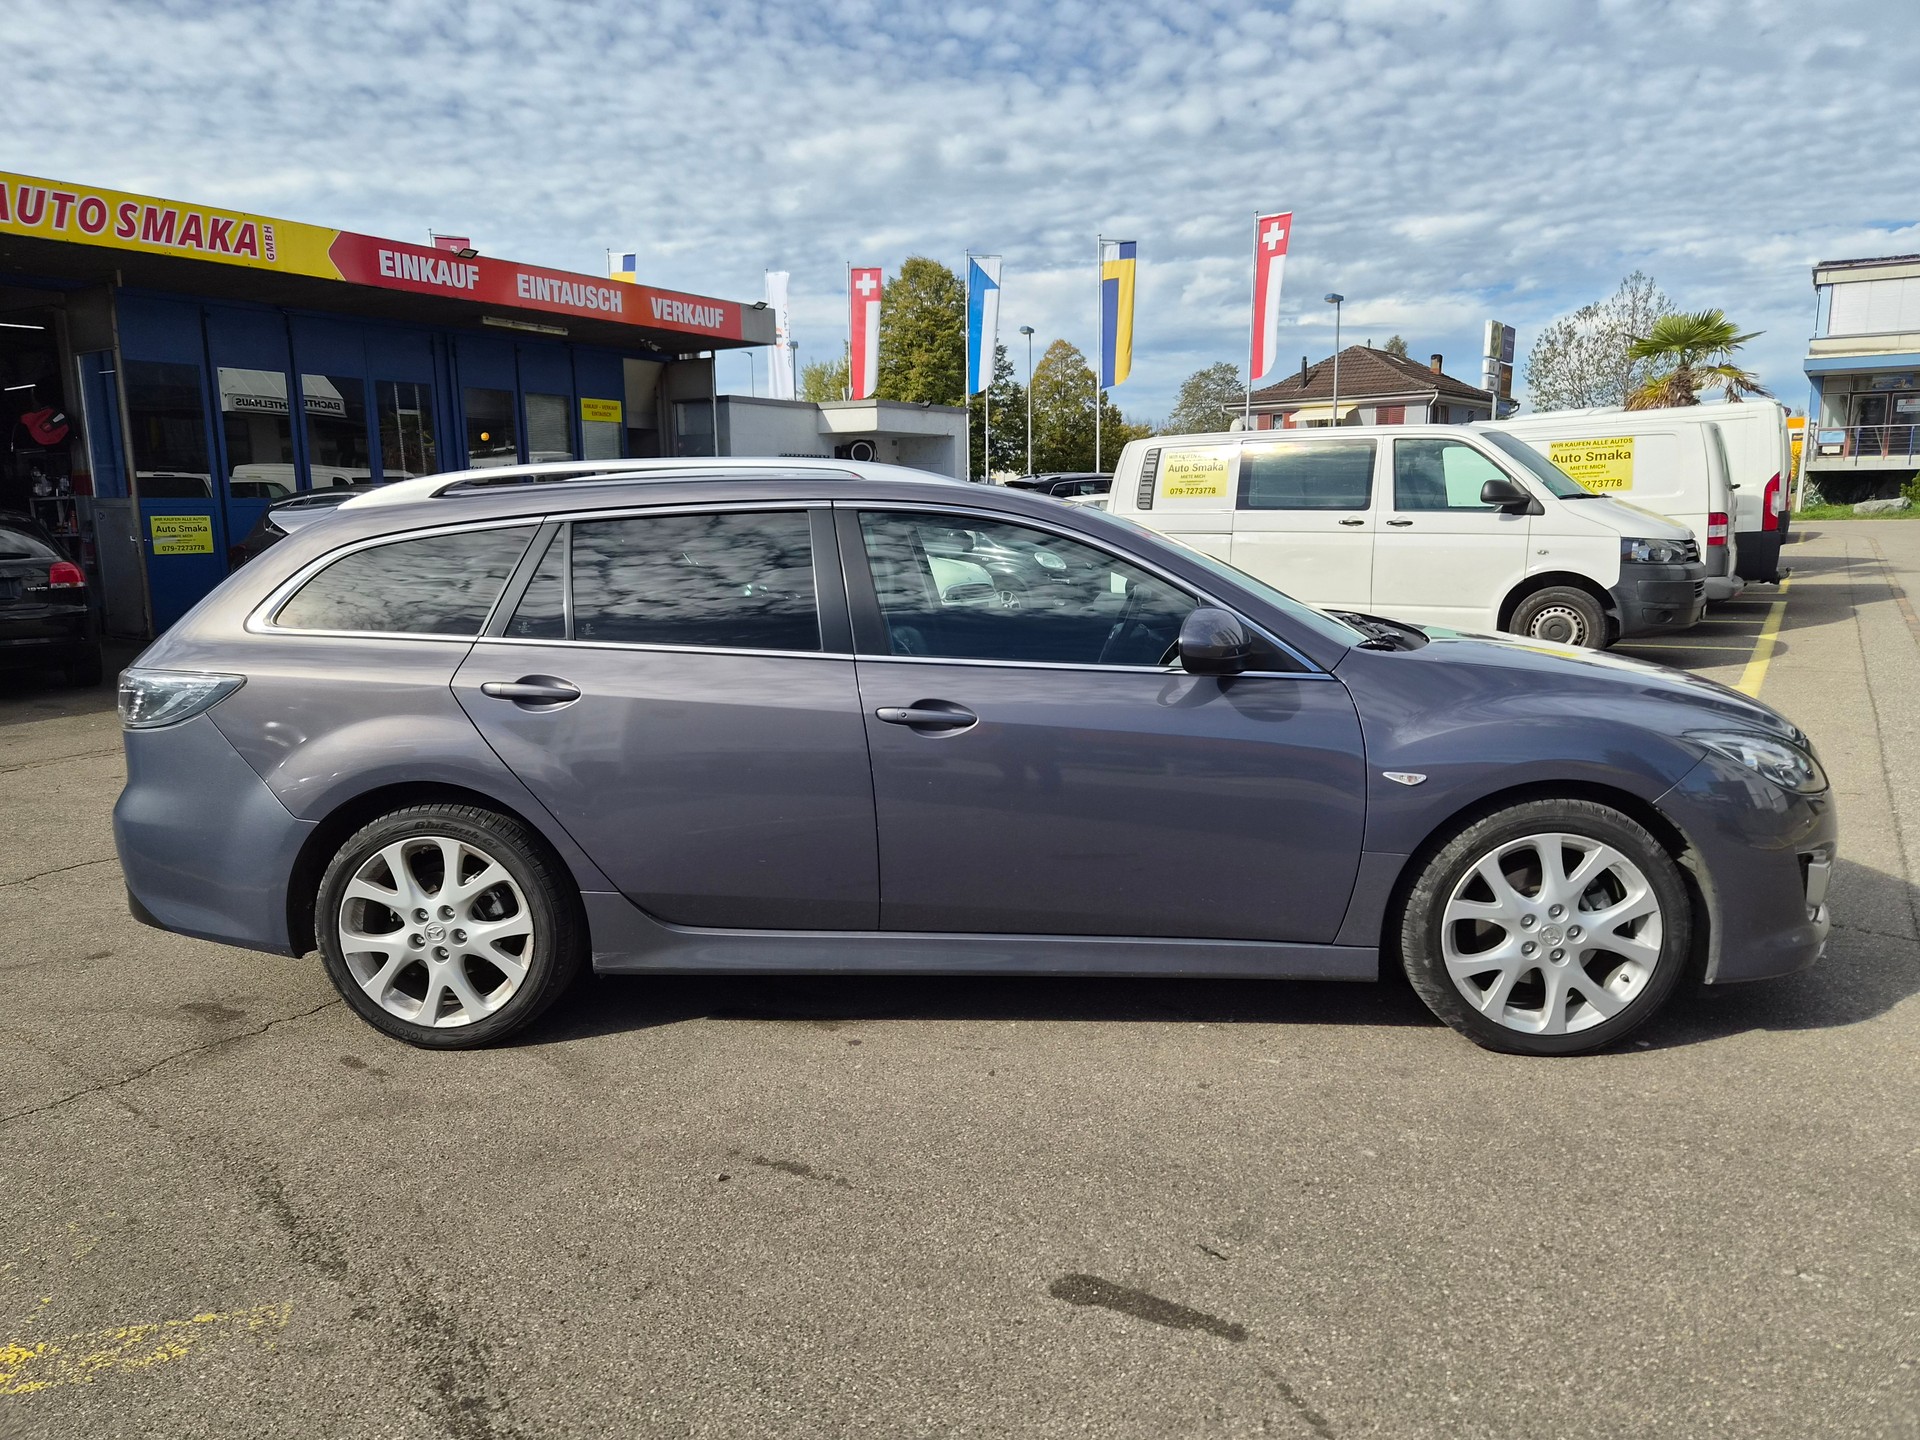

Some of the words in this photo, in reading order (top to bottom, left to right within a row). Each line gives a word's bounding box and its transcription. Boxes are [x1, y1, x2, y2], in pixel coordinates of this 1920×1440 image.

[115, 202, 260, 259] SMAKA
[265, 224, 276, 262] GMBH
[379, 249, 479, 290] EINKAUF
[517, 273, 622, 313] EINTAUSCH
[651, 297, 724, 329] VERKAUF
[1564, 440, 1591, 448] KAUFEN
[1552, 453, 1582, 463] Auto
[1585, 449, 1631, 461] Smaka
[1168, 464, 1190, 472] Auto
[1191, 461, 1224, 472] Smaka
[1169, 487, 1216, 495] 079-7273778
[178, 524, 208, 532] Smaka
[369, 1012, 425, 1042] YOKOHAMA
